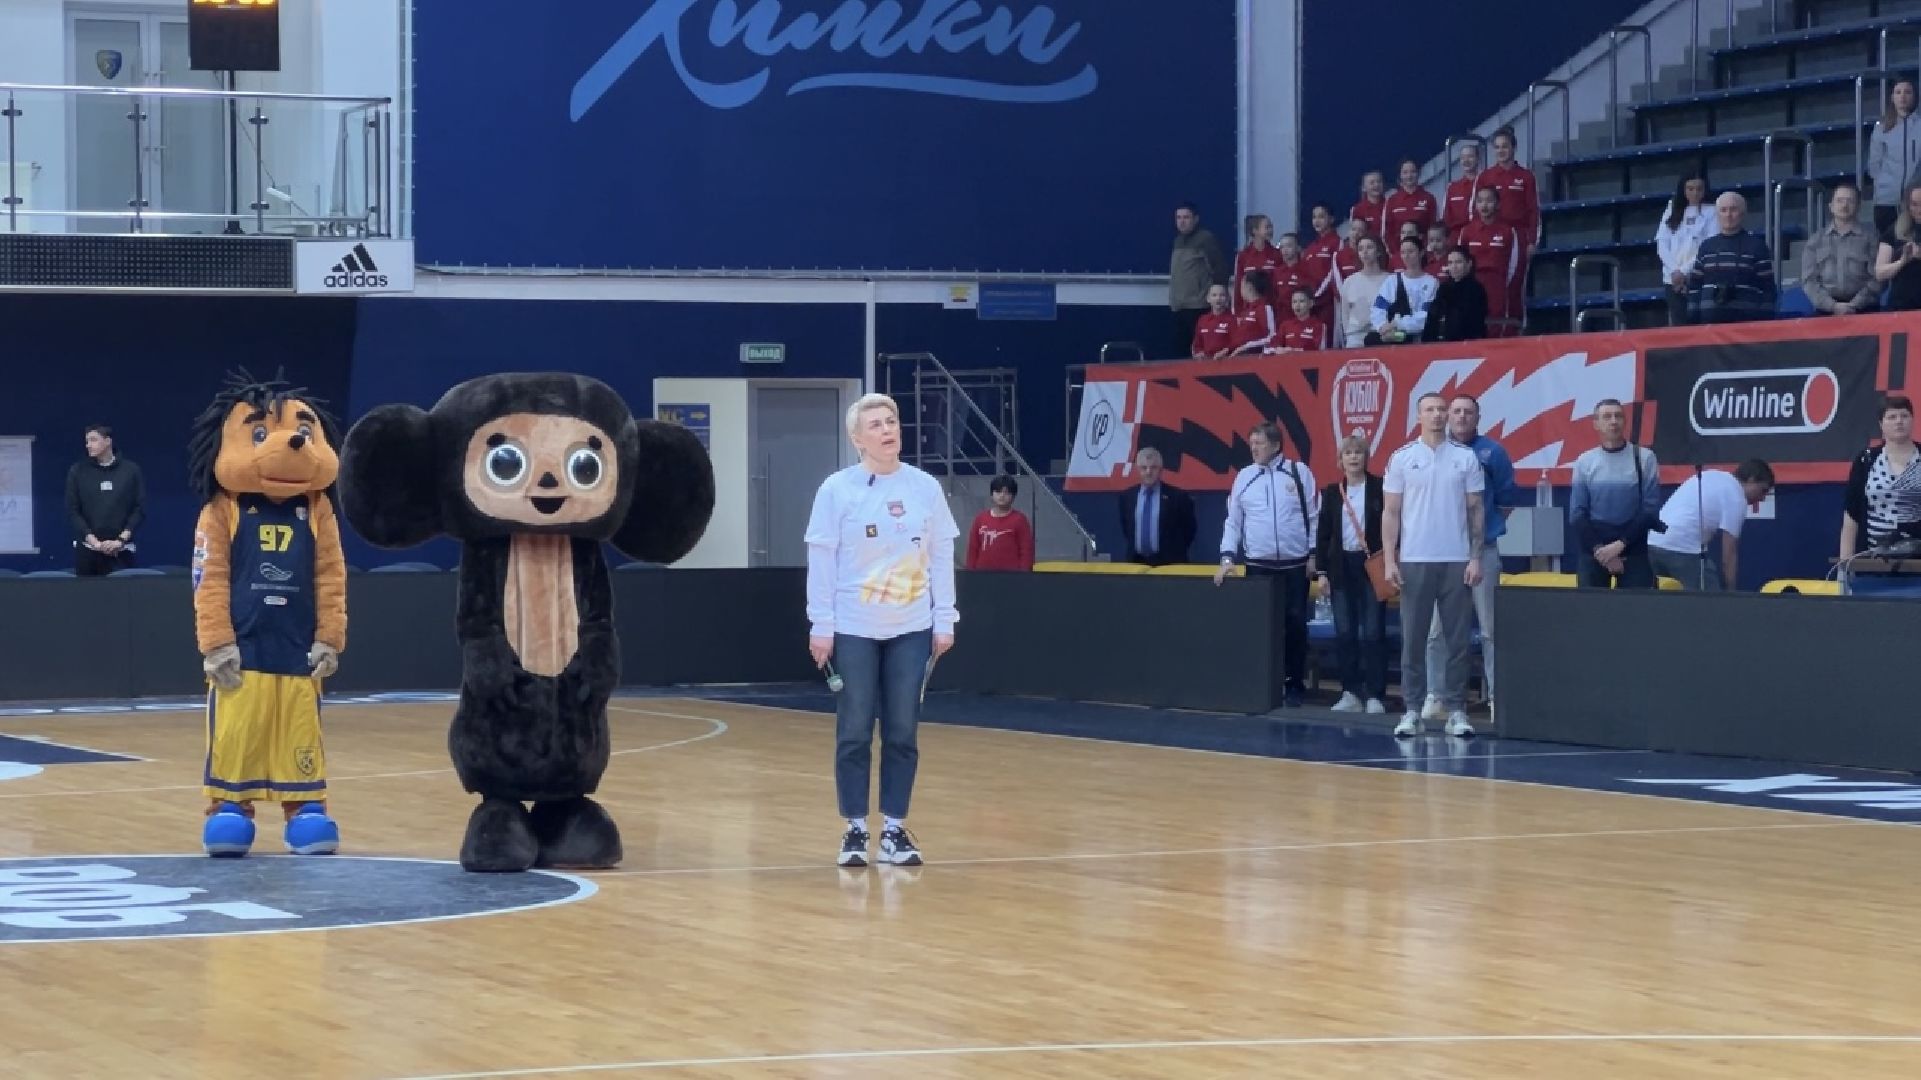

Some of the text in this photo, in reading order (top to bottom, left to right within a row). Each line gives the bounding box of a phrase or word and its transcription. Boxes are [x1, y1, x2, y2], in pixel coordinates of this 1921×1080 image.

[324, 272, 388, 288] adidas
[1704, 386, 1796, 419] Winline
[259, 524, 294, 552] 97
